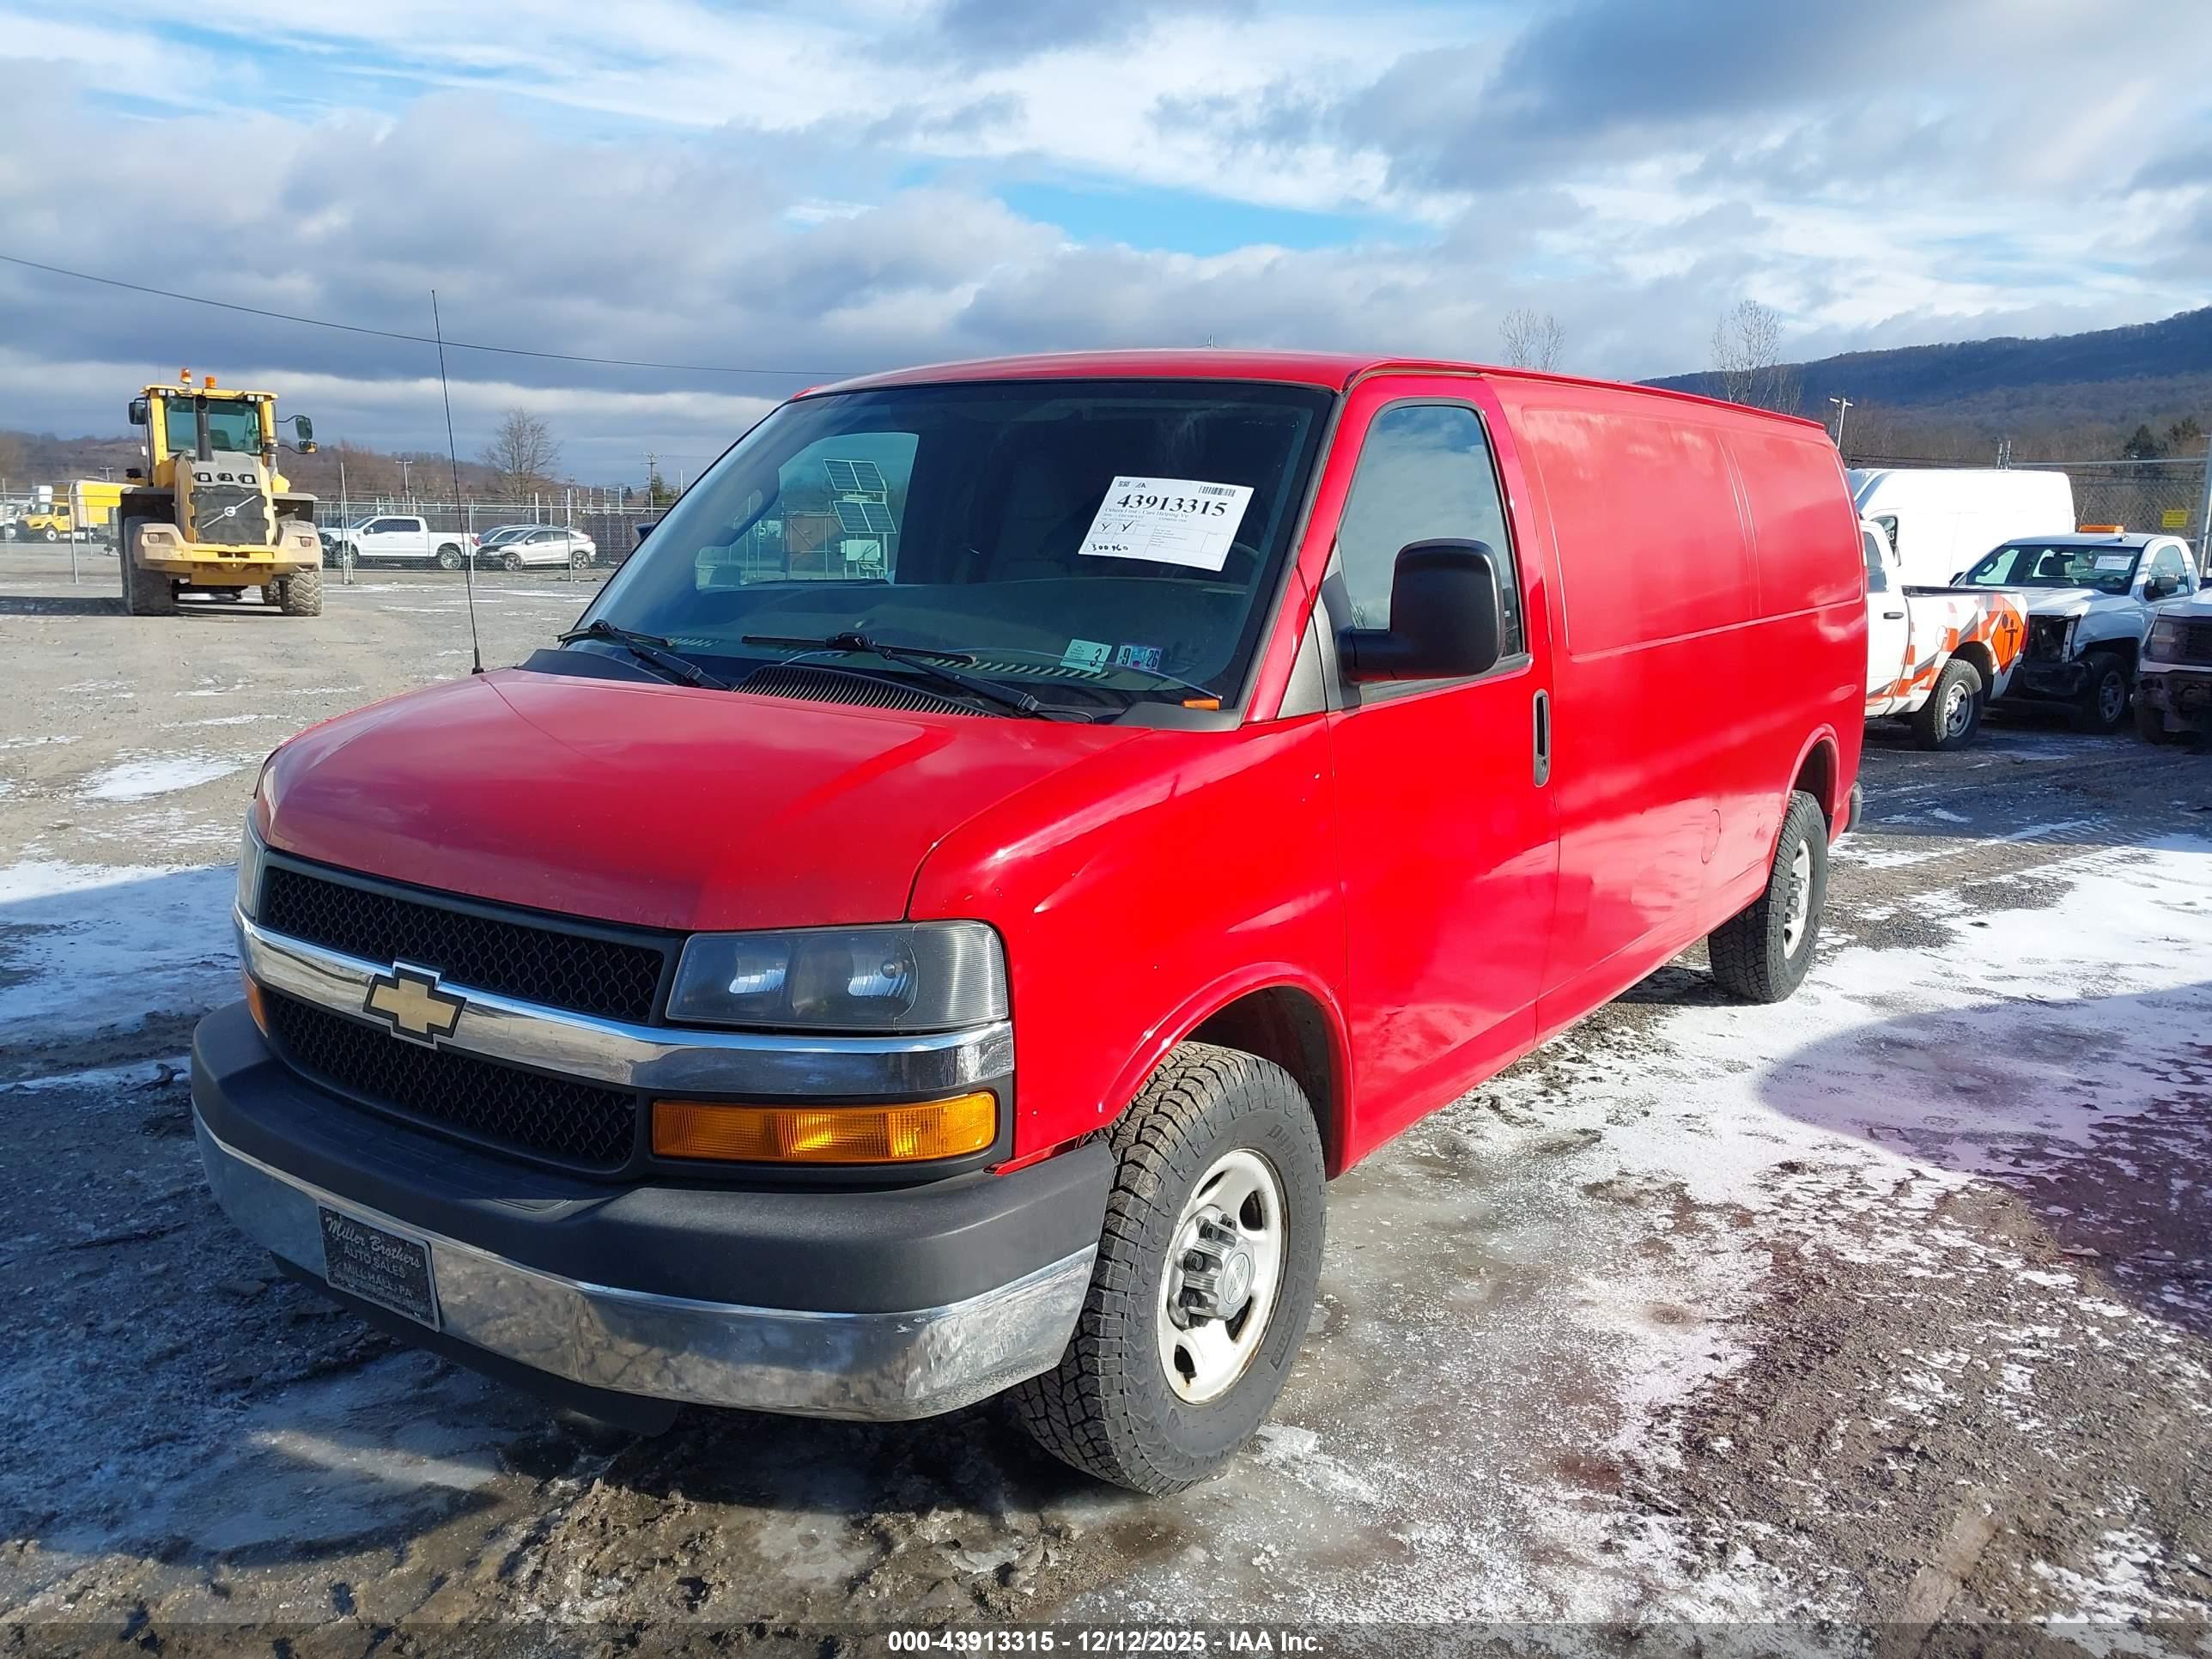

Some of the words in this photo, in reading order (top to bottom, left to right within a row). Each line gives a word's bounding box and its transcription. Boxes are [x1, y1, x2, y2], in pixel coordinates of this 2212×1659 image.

[1116, 494, 1229, 517] 43913315
[1090, 648, 1102, 667] 3
[1146, 650, 1159, 667] 26
[325, 1216, 366, 1247] Miller
[369, 1235, 422, 1268] Brothers
[343, 1242, 372, 1264] AUTO
[373, 1256, 406, 1279] SALES
[343, 1261, 367, 1279] MILL
[398, 1285, 413, 1298] PA
